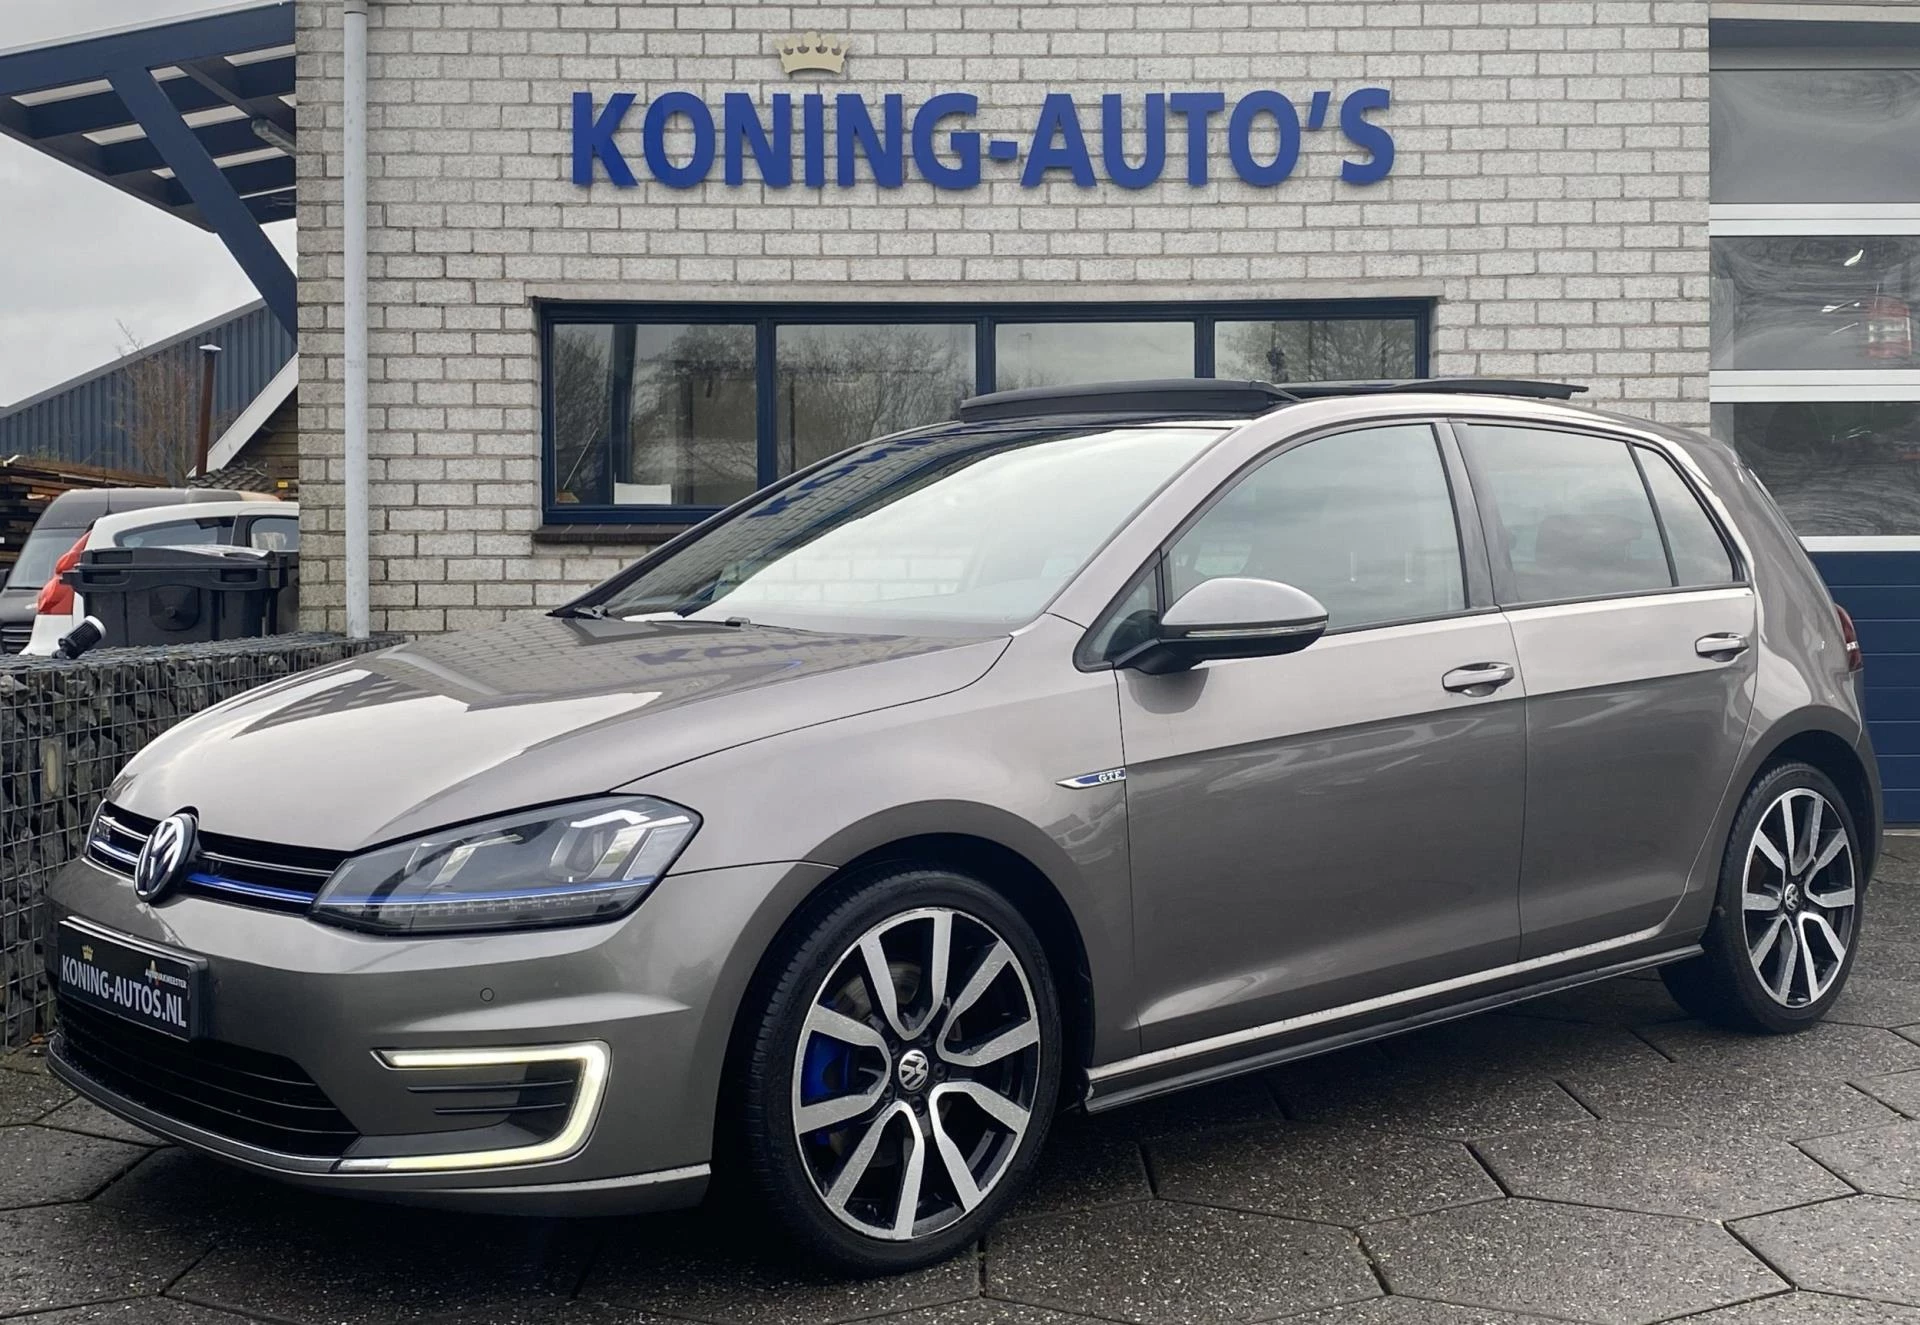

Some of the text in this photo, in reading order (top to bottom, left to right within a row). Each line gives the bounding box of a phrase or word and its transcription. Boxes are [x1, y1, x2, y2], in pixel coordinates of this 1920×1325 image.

[572, 88, 1396, 190] KONING-AUTO'S
[1099, 770, 1121, 783] GTE
[62, 954, 187, 1028] KONING-AUTOS.NL
